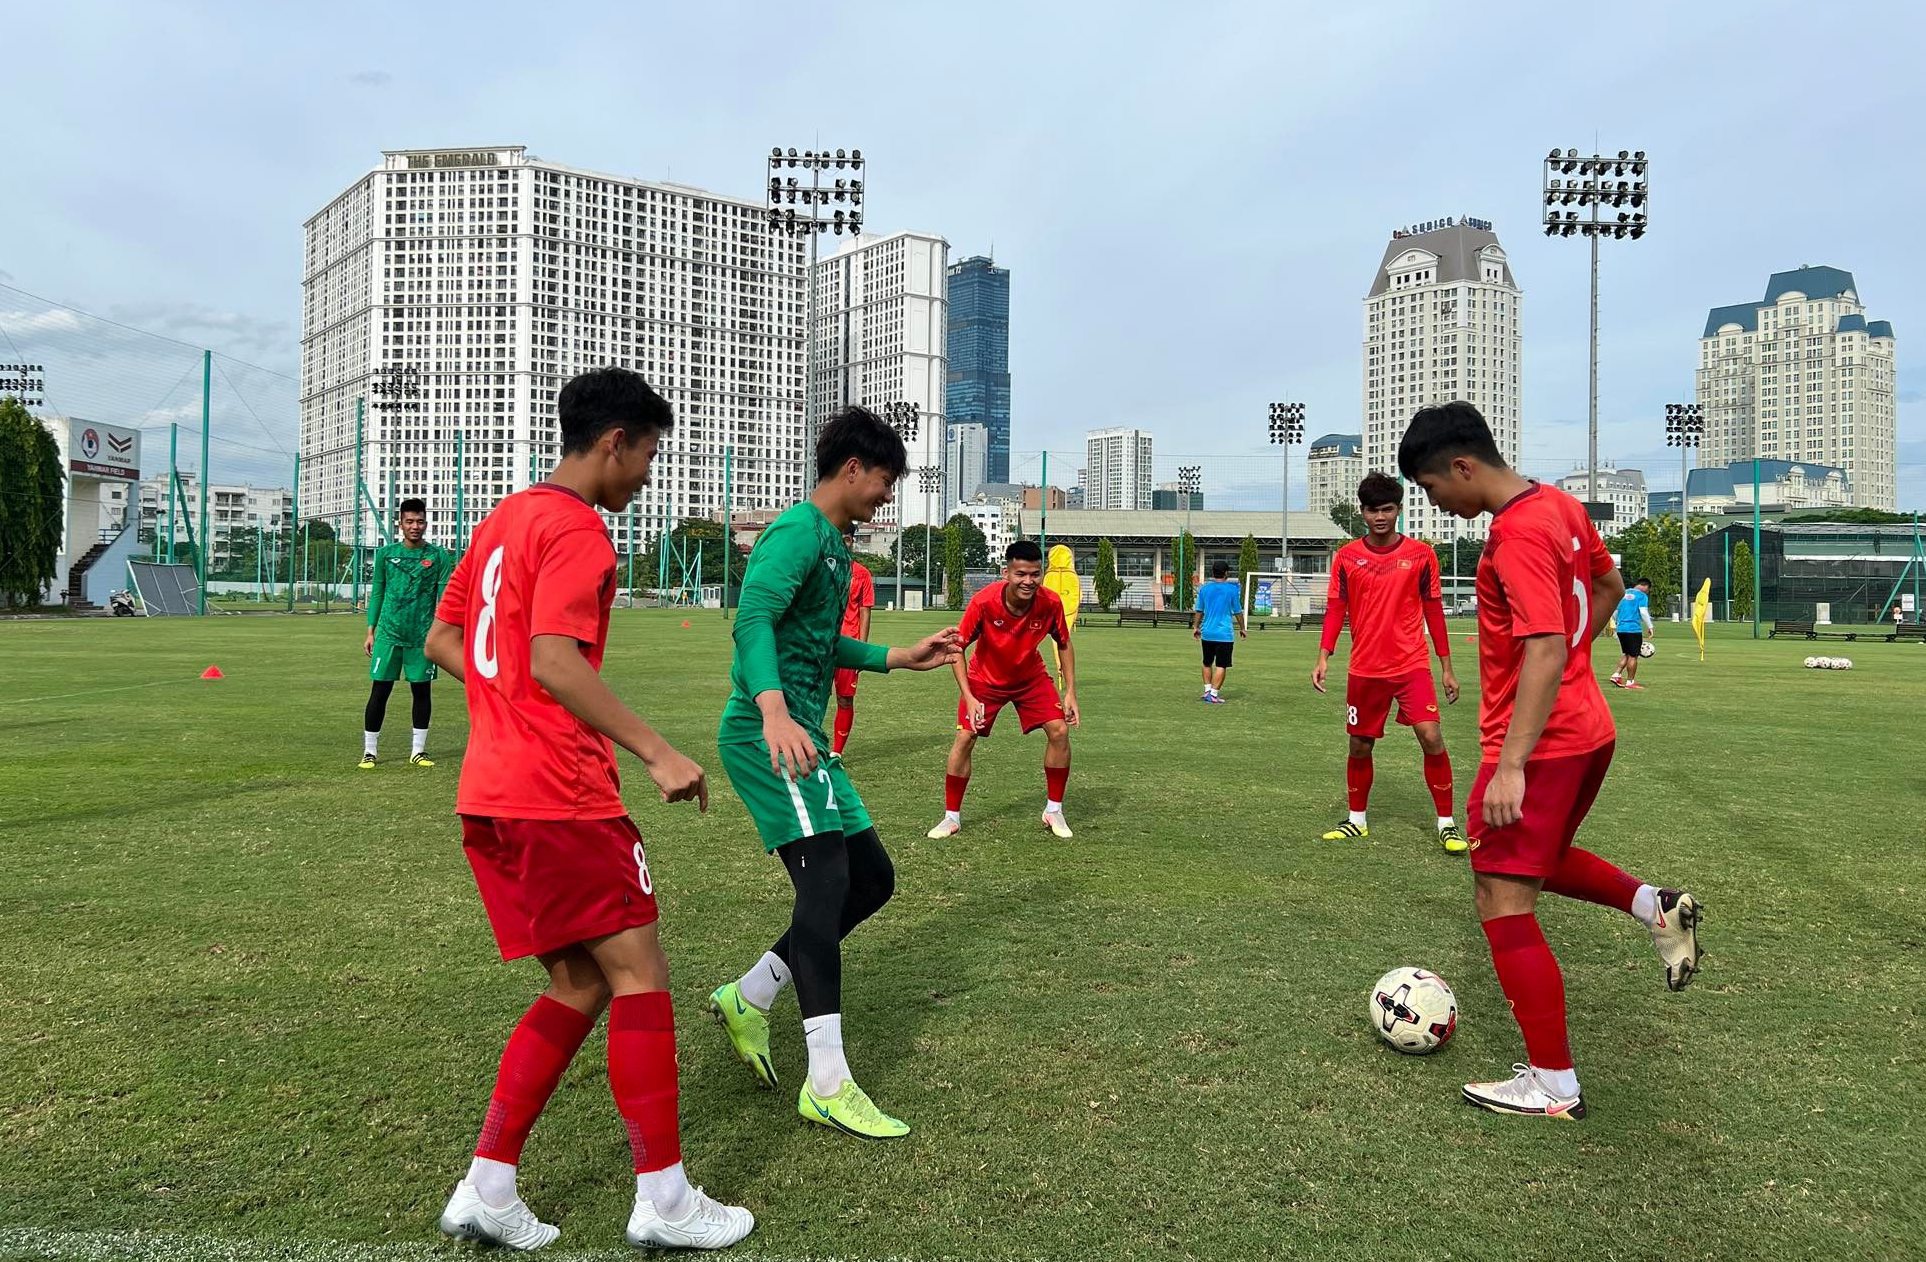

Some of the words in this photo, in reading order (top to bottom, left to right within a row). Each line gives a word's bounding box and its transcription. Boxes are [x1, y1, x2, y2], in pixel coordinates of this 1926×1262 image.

[406, 155, 429, 168] THE
[434, 152, 497, 167] EMERALD
[1412, 216, 1453, 234] SUDICO
[110, 467, 126, 476] FIELD
[474, 545, 504, 679] 8
[373, 657, 381, 674] 1
[1346, 703, 1358, 726] 8
[818, 768, 838, 810] 2
[633, 842, 653, 895] 8
